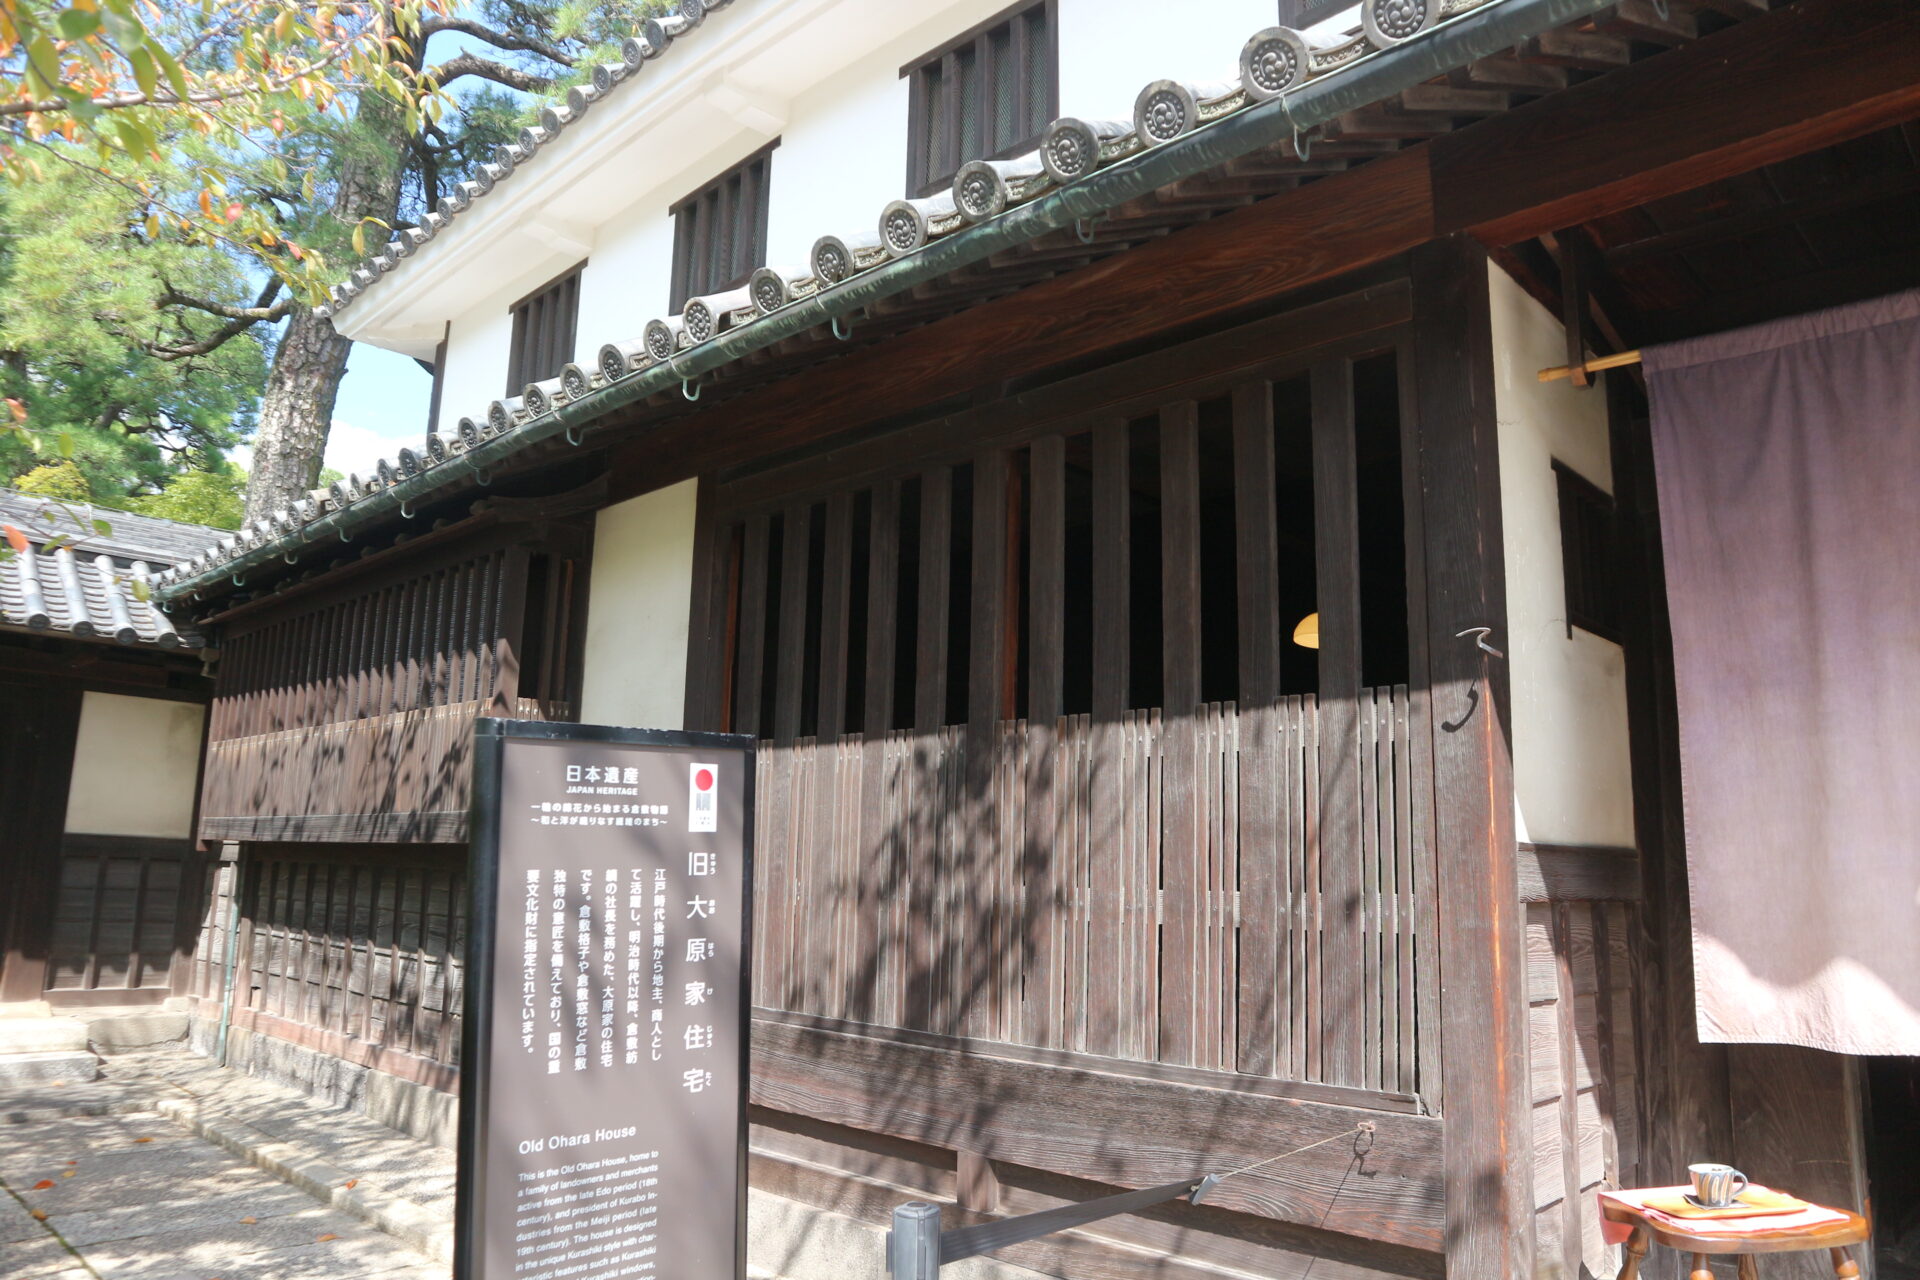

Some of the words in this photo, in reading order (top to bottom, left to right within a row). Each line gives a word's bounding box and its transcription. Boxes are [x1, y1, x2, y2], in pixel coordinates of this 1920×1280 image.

[566, 765, 639, 784] 日本遺産
[566, 786, 594, 794] JAPAN
[597, 787, 638, 795] HERITAGE
[683, 852, 708, 1093] 旧大原家住宅
[519, 1138, 544, 1155] Old
[549, 1132, 590, 1150] Ohara
[595, 1125, 636, 1142] House
[519, 1173, 535, 1182] This
[547, 1169, 559, 1178] the
[561, 1165, 574, 1175] Old
[577, 1162, 600, 1171] Ohara
[630, 1153, 649, 1162] home
[652, 1150, 658, 1158] to
[526, 1184, 549, 1196] family
[551, 1182, 559, 1190] of
[561, 1174, 603, 1189] landowners
[605, 1170, 619, 1180] and
[621, 1164, 658, 1178] merchants
[517, 1202, 542, 1212] active
[544, 1196, 562, 1206] from
[565, 1194, 577, 1202] the
[580, 1191, 594, 1199] late
[596, 1188, 611, 1196] Edo
[613, 1181, 636, 1194] period
[555, 1209, 570, 1219] and
[572, 1202, 608, 1217] president
[610, 1198, 618, 1208] of
[620, 1194, 646, 1206] Kurabo
[517, 1228, 551, 1241] dustries
[554, 1224, 572, 1234] from
[575, 1220, 588, 1229] the
[591, 1214, 610, 1226] Meiji
[612, 1210, 637, 1222] period
[574, 1234, 588, 1244] The
[591, 1229, 613, 1239] house
[616, 1225, 622, 1234] is
[624, 1219, 657, 1234] designed
[516, 1263, 524, 1271] in
[525, 1261, 537, 1269] the
[539, 1254, 566, 1267] unique
[568, 1244, 602, 1259] Kurashiki
[604, 1241, 620, 1252] style
[623, 1238, 637, 1247] with
[555, 1264, 588, 1277] features
[590, 1256, 608, 1269] such
[610, 1255, 619, 1264] as
[622, 1246, 656, 1261] Kurashiki
